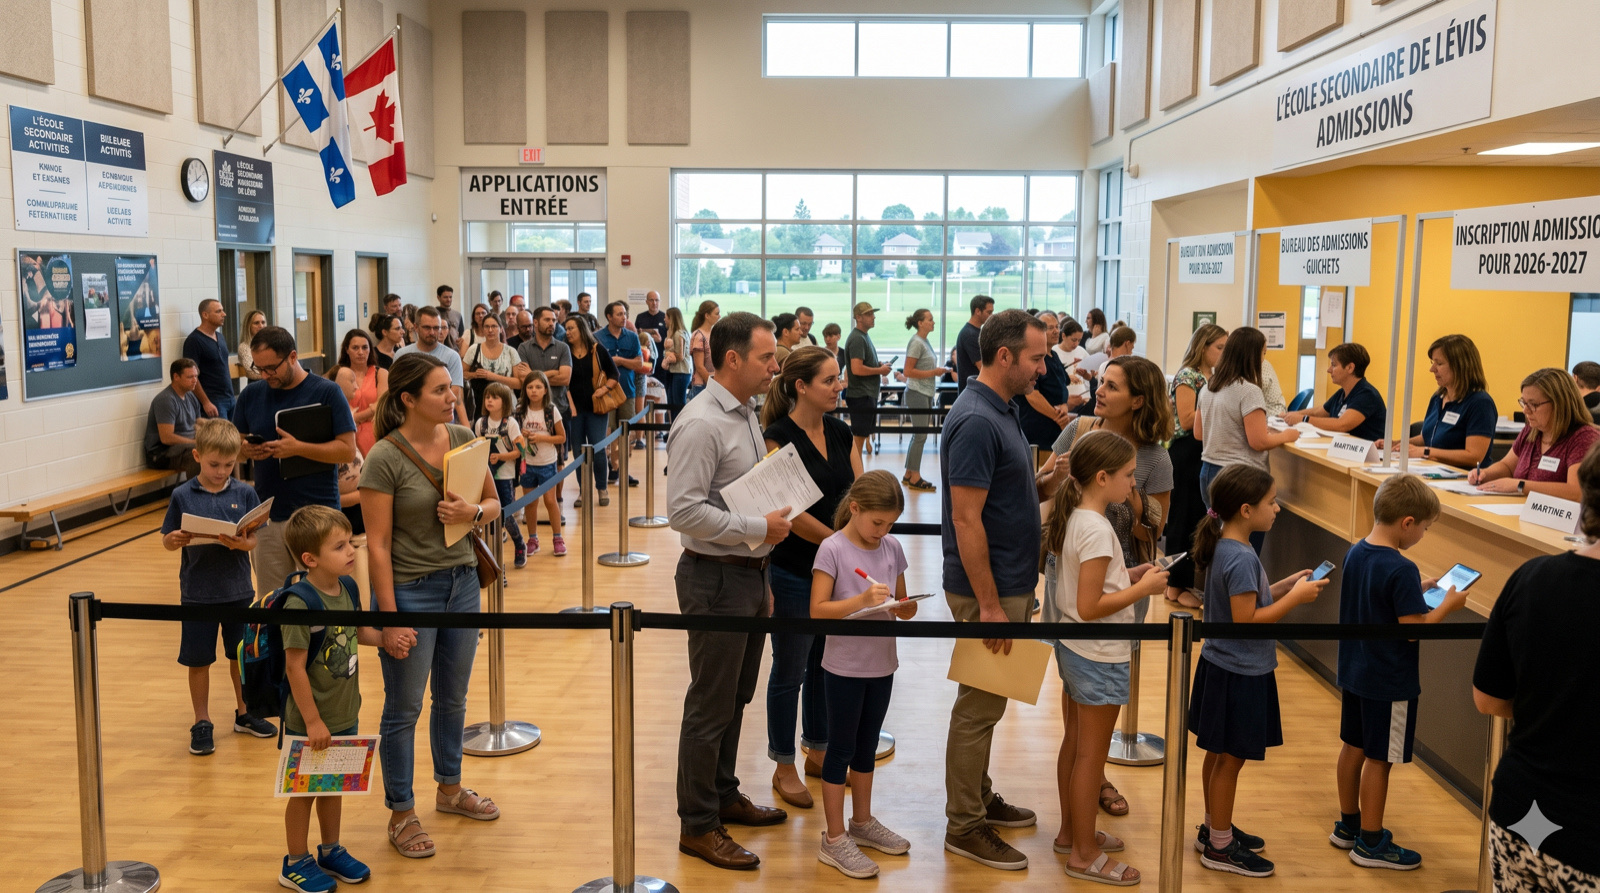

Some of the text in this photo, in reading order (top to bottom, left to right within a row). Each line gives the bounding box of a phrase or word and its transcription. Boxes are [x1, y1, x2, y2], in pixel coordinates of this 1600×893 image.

[1276, 14, 1487, 122] L'ÉCOLE SECONDAIRE DE LÉVIS
[32, 115, 64, 130] L'ÉCOLE
[1316, 89, 1414, 148] ADMISSIONS
[24, 126, 74, 144] SECONDAIRE
[28, 139, 70, 155] ACTIVITIES
[523, 148, 542, 162] EXIT
[33, 173, 41, 181] ET
[469, 175, 599, 193] APPLICATIONS
[500, 195, 568, 216] ENTRÉE
[1456, 220, 1530, 246] INSCRIPTION
[1281, 232, 1369, 254] BUREAU DES ADMISSIONS
[1306, 258, 1340, 275] GUICHETS
[1479, 251, 1588, 275] POUR 2026-2027
[1334, 441, 1359, 452] MARTINE
[1531, 502, 1573, 520] MARTINE R.
